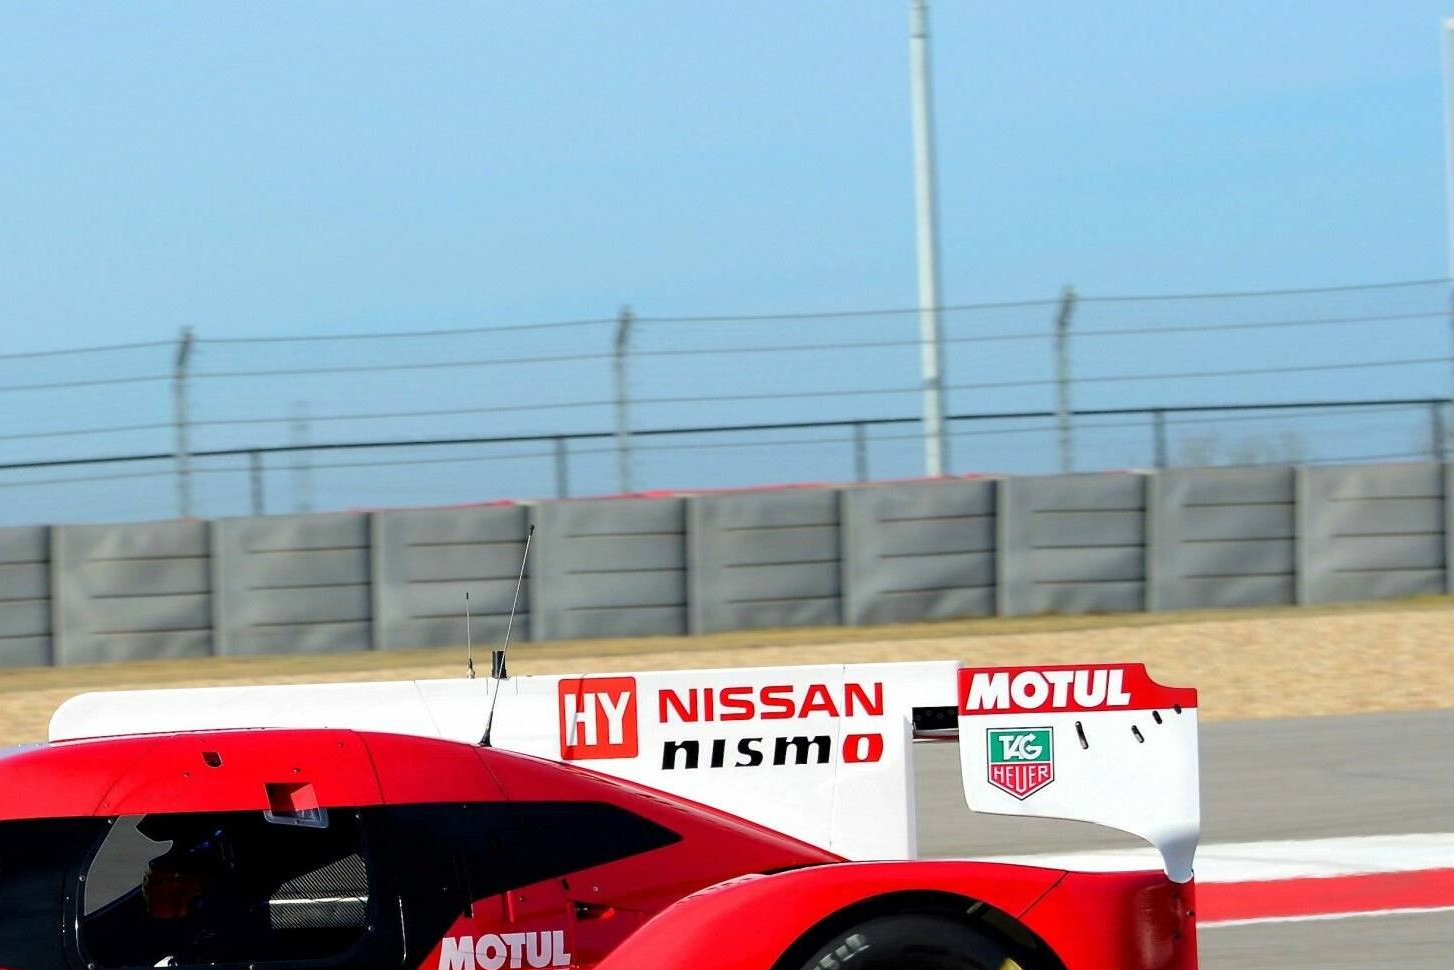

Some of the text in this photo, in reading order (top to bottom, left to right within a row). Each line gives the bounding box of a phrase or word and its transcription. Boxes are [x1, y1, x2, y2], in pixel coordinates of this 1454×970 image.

[659, 682, 883, 723] NISSAN
[966, 669, 1131, 710] MOTUL
[564, 692, 631, 746] HY
[661, 733, 884, 770] nismo
[999, 733, 1042, 760] TAG
[994, 765, 1048, 793] HEUER
